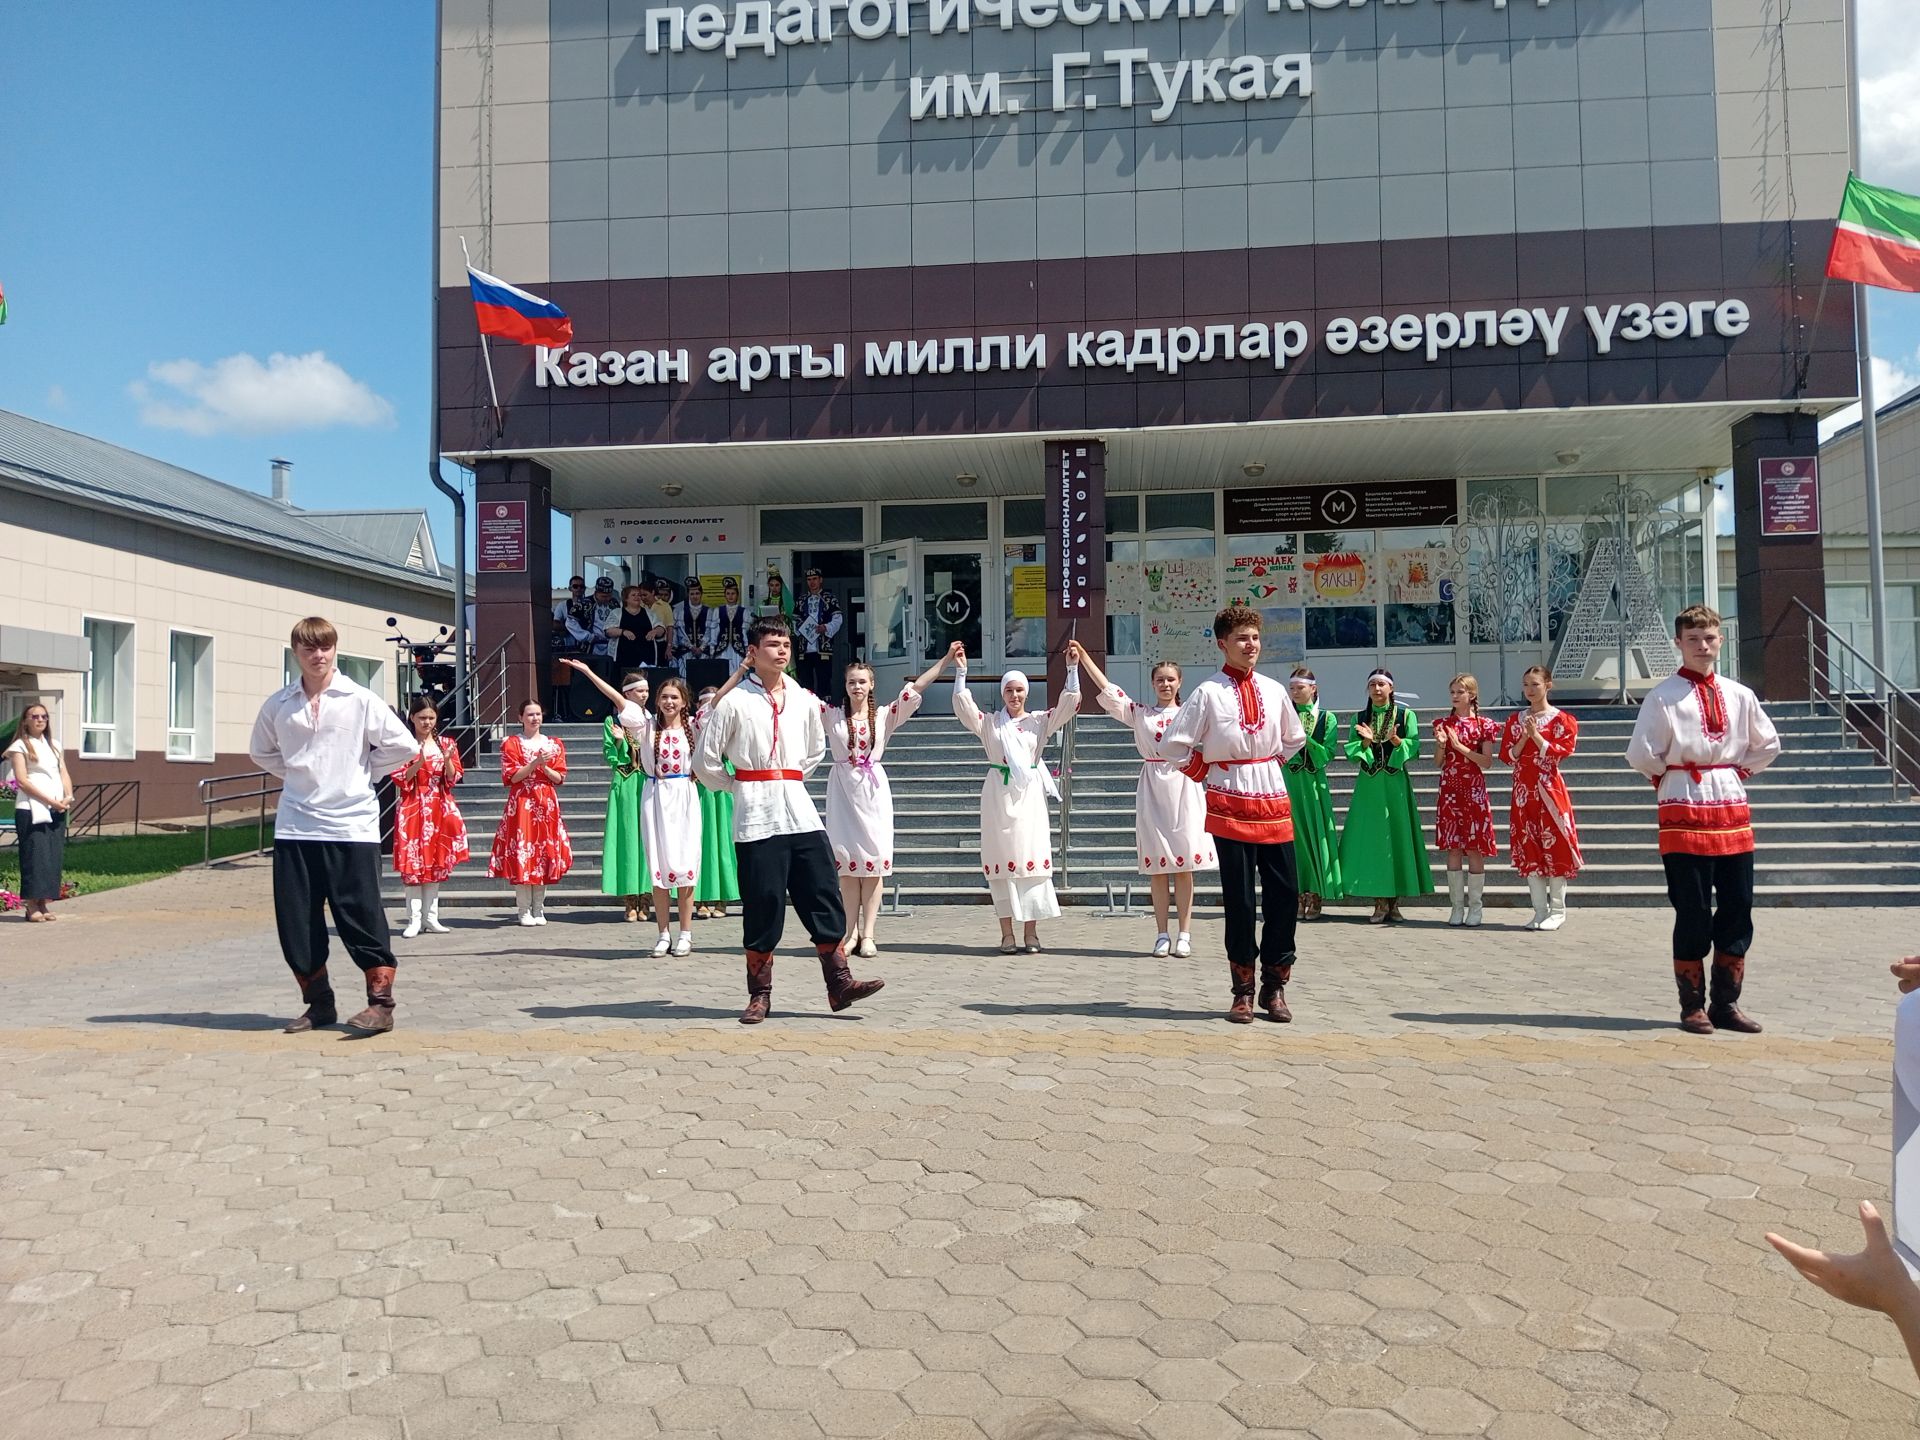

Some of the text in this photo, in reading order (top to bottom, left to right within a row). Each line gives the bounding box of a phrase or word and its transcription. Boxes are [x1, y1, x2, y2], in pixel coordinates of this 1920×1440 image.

[645, 0, 1236, 59] педагогическ
[910, 48, 1312, 123] им. Г.Тукая
[535, 298, 1750, 391] Казан арты милли кадрлар әзерләү үзәге
[620, 518, 725, 526] ПРОФЕССИОНАЛИТЕТ
[1062, 449, 1071, 609] ПРОФЕССИОНАЛИТЕТ
[1320, 571, 1357, 588] ЯЛКЫН
